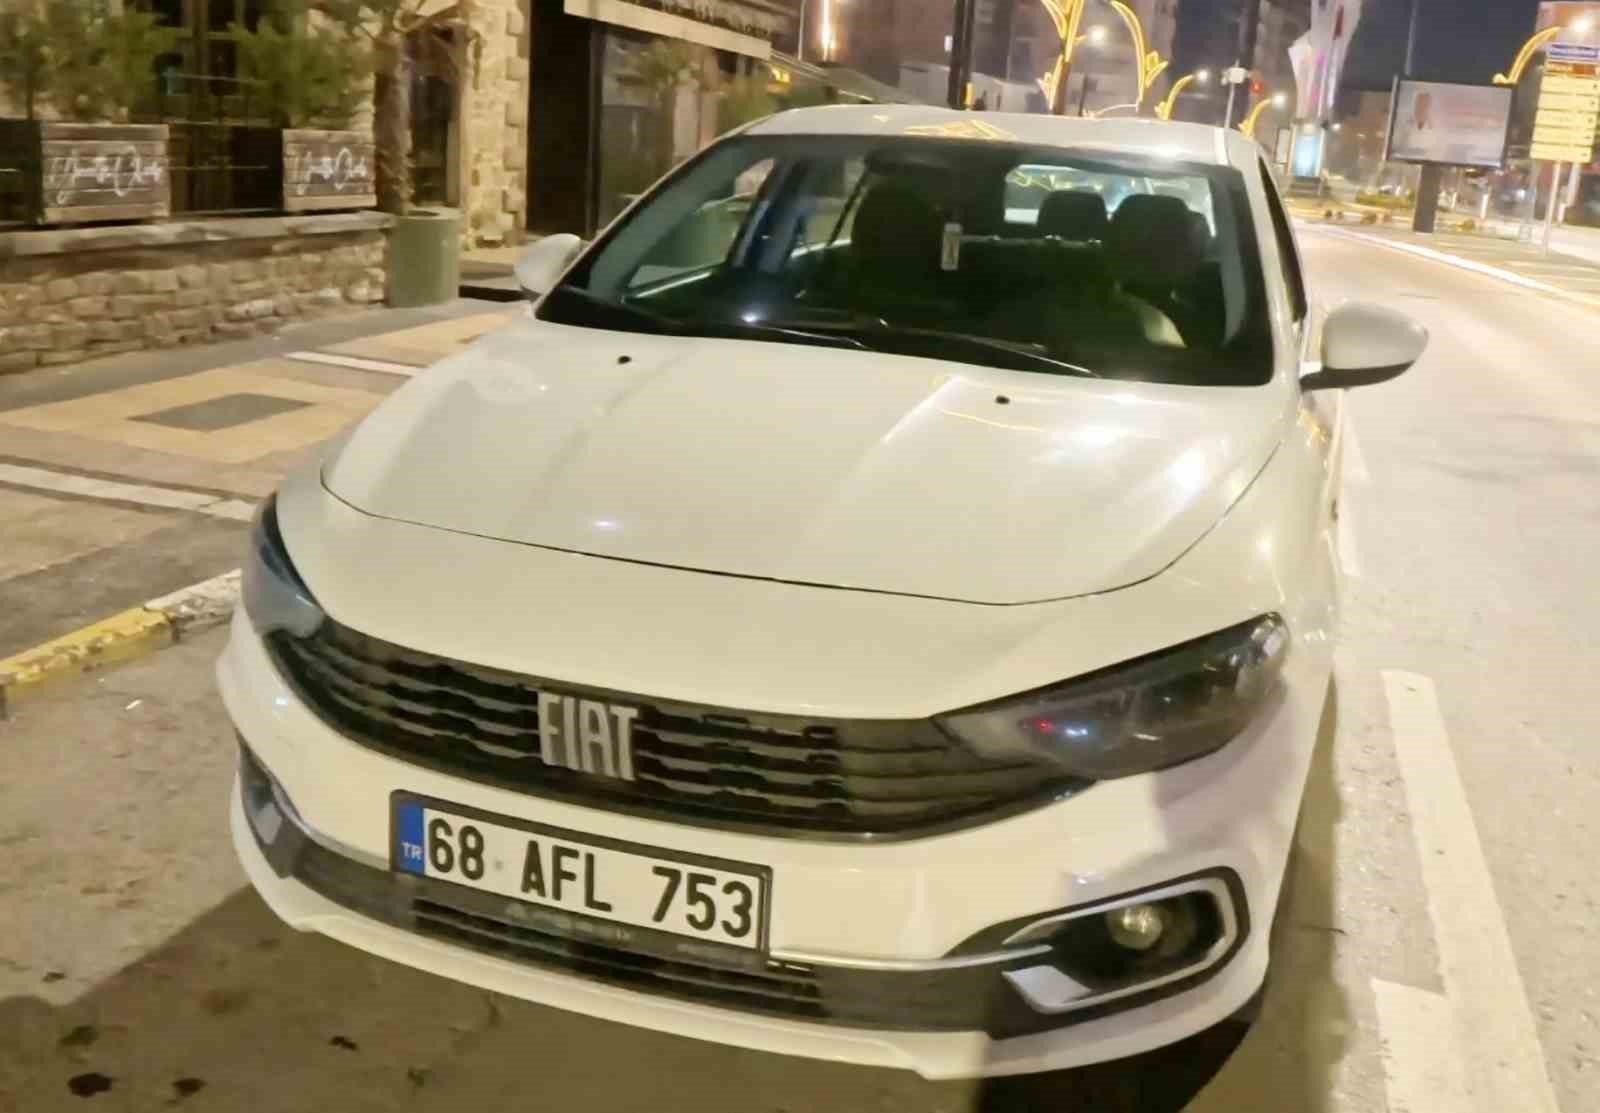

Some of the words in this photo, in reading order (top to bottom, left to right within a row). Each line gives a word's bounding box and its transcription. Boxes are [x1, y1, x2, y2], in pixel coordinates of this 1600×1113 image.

[537, 691, 638, 781] FIAT
[401, 841, 423, 861] TR
[428, 817, 485, 880] 68
[520, 840, 612, 912] AFL
[652, 866, 753, 938] 753
